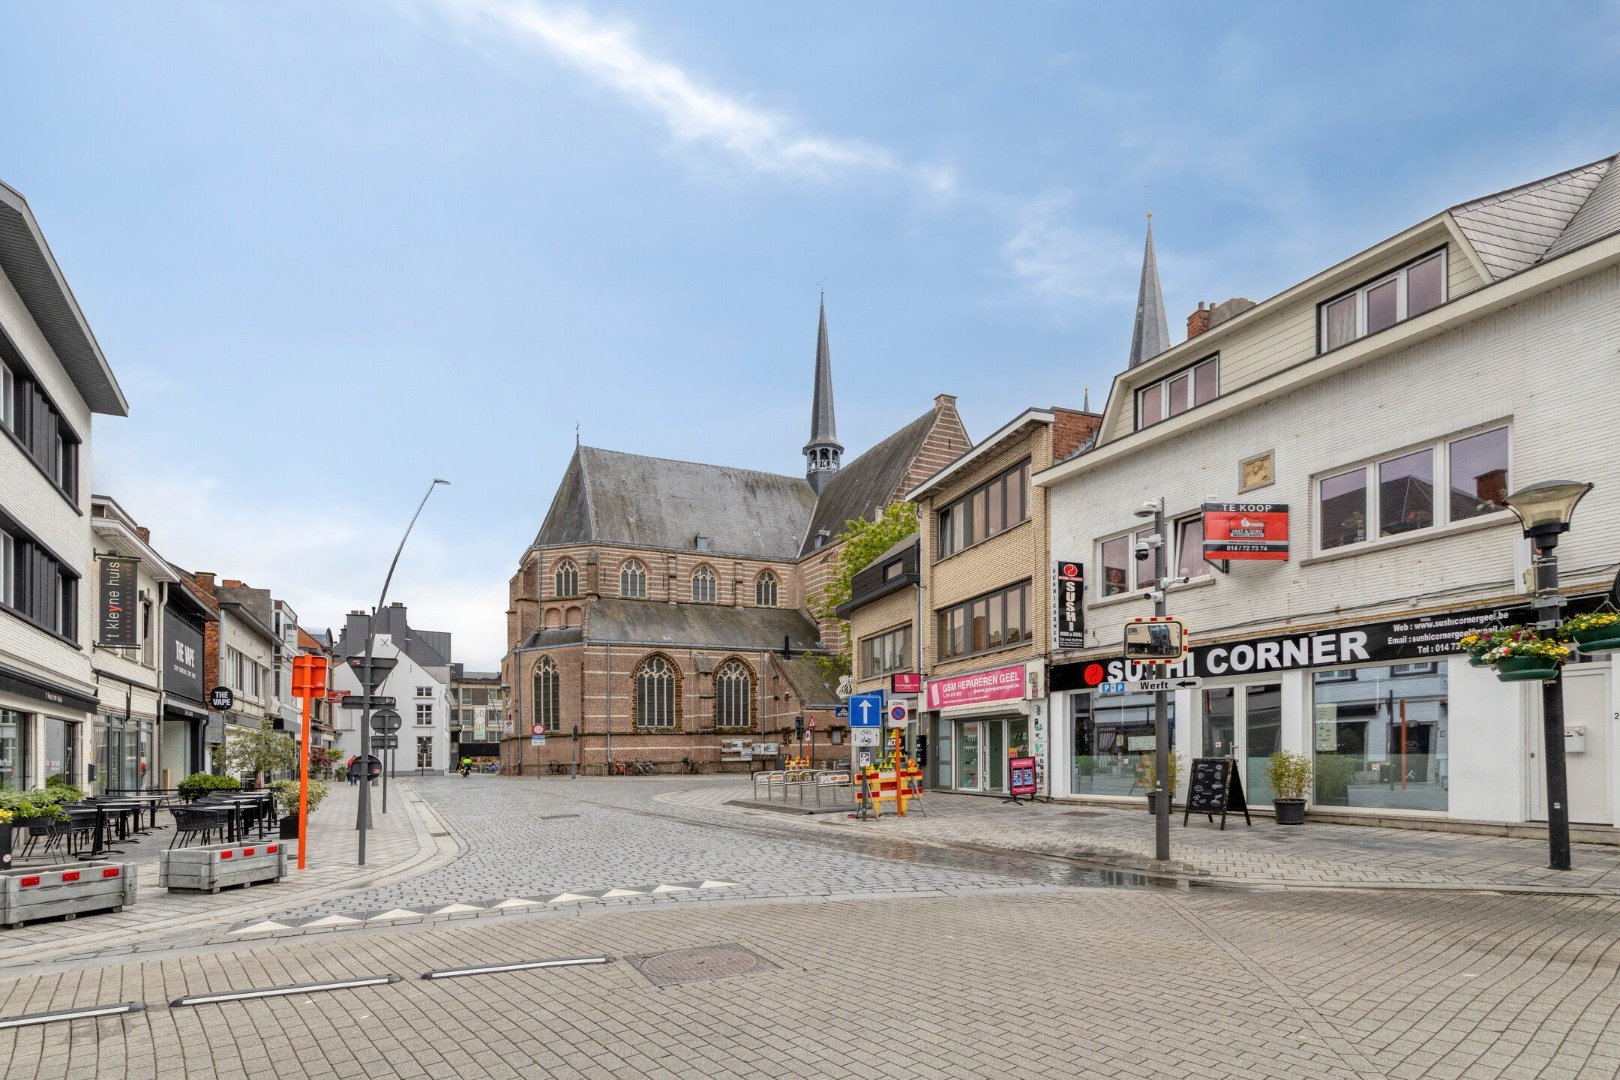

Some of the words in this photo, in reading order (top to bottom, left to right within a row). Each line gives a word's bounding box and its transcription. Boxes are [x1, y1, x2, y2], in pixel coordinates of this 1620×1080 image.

[1222, 504, 1236, 512] TE
[1240, 504, 1272, 512] KOOP
[107, 561, 120, 586] huis
[106, 590, 122, 629] kleyne
[1066, 582, 1076, 631] SUSHI
[1393, 623, 1408, 632] Web
[1387, 636, 1408, 645] Email
[1417, 645, 1429, 653] Tel
[1435, 643, 1449, 652] 014
[1451, 641, 1461, 650] 73
[1107, 652, 1194, 682] SUHI
[1207, 631, 1370, 674] CORNER
[943, 684, 956, 692] GSM
[958, 675, 998, 689] REPAREREN
[1000, 672, 1020, 683] GEEL
[1140, 680, 1168, 690] Werft
[213, 698, 230, 706] VAPE
